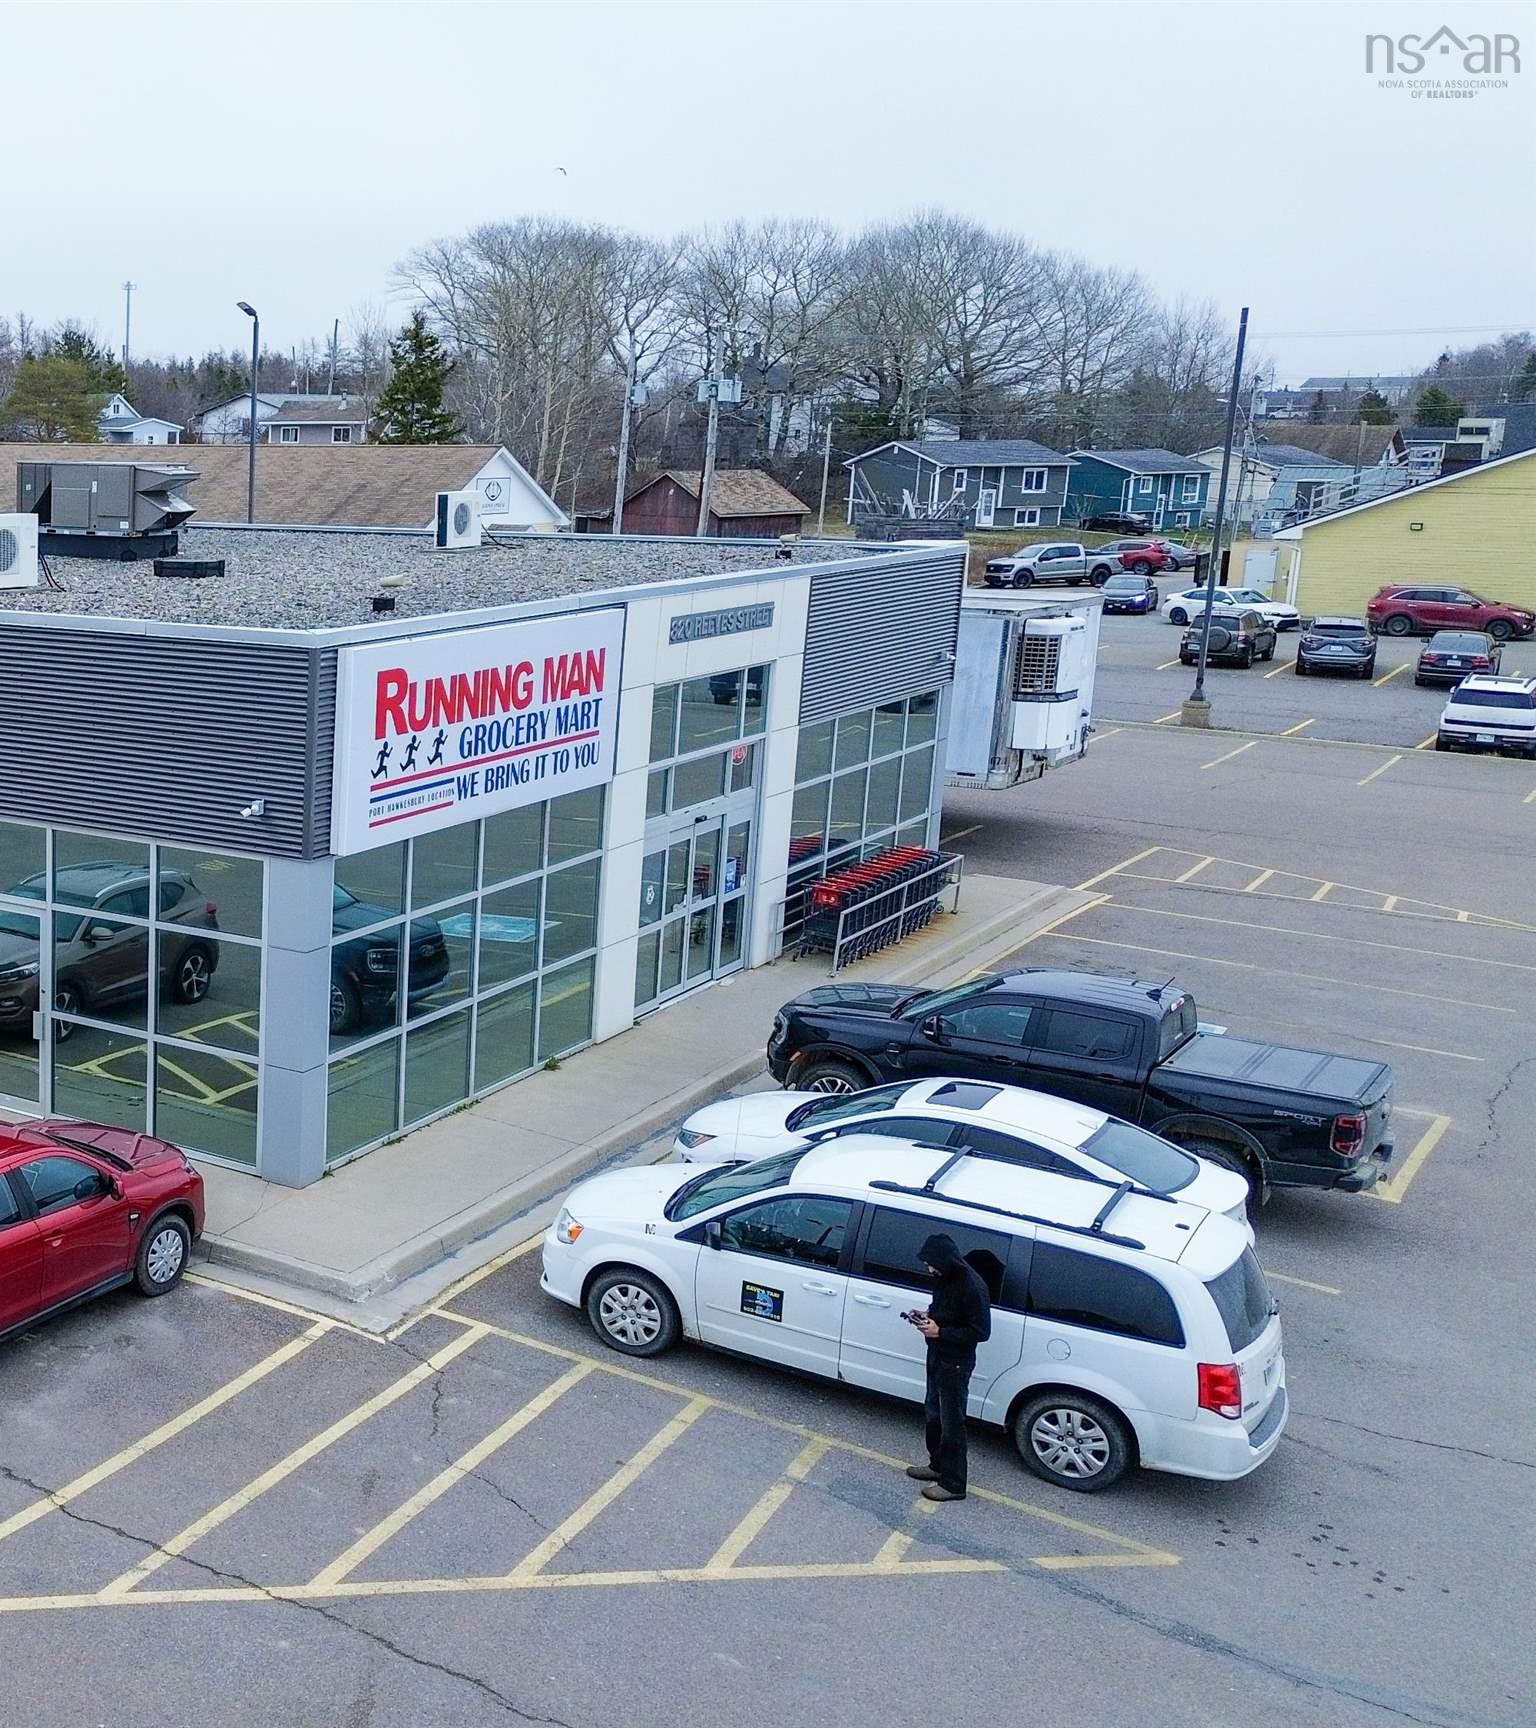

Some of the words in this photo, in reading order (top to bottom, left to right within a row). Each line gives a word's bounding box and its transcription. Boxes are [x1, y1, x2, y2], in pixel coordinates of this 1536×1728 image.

[670, 617, 693, 641] 820
[694, 612, 737, 638] REEVES
[736, 606, 775, 630] STREET
[375, 660, 534, 740] RUNNING
[542, 647, 606, 704] MAN
[459, 709, 551, 760] GROCERY
[554, 697, 603, 737] MART
[456, 771, 479, 801] WE
[484, 758, 530, 794] BRING
[534, 752, 549, 780] IT
[551, 748, 570, 775] TO
[574, 741, 601, 769] YOU
[368, 805, 385, 818] PORT
[427, 787, 455, 802] LOCATION
